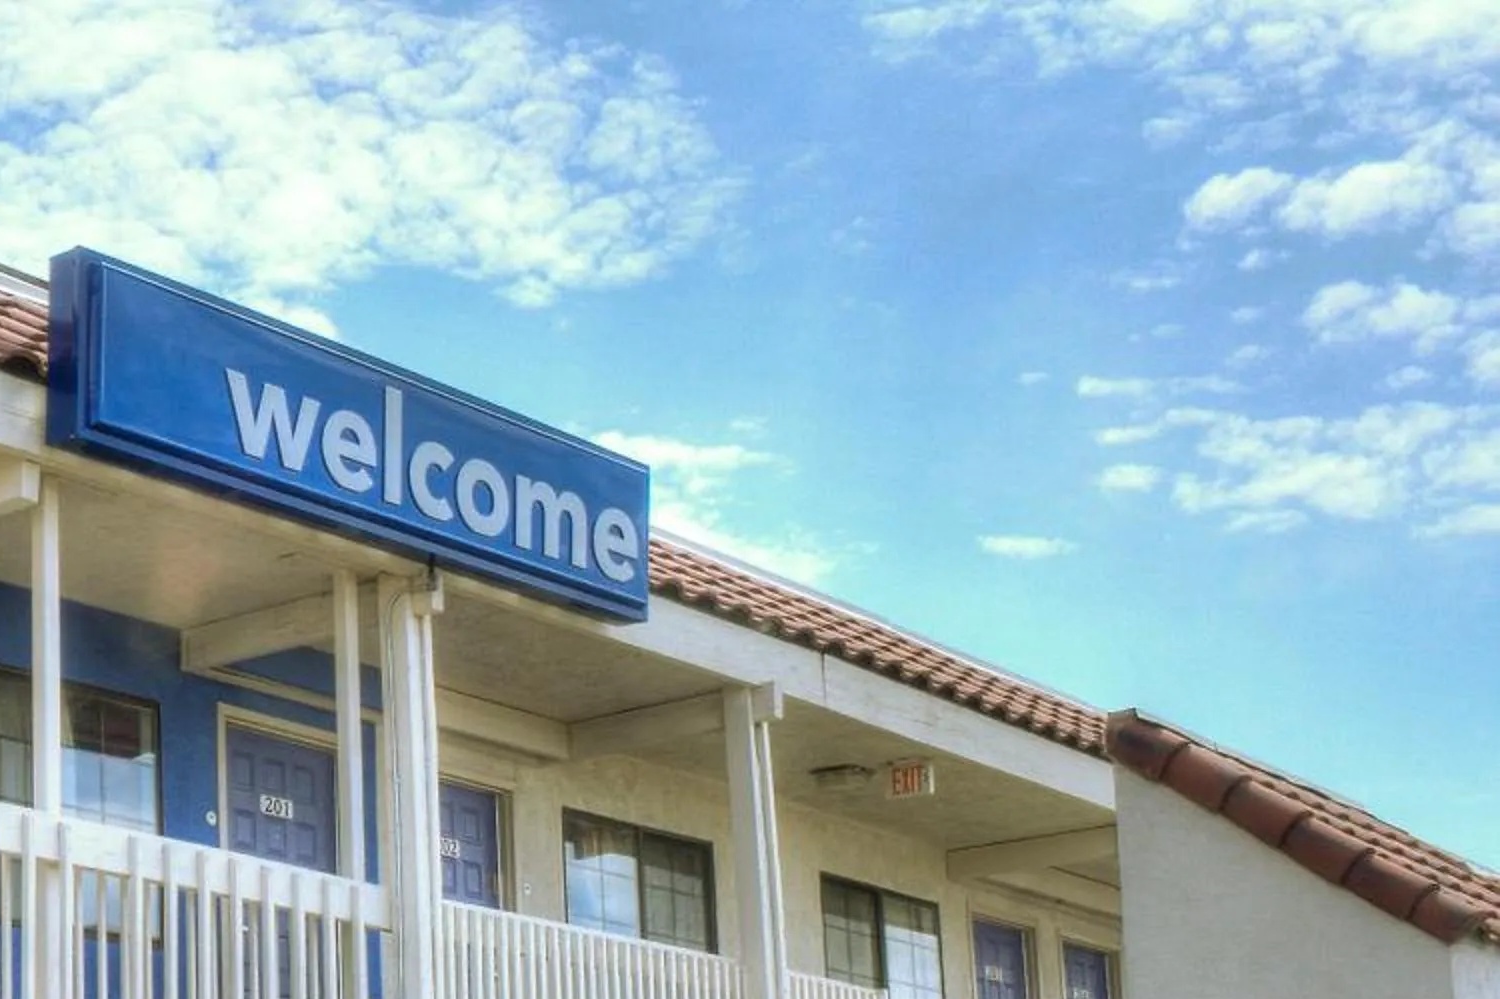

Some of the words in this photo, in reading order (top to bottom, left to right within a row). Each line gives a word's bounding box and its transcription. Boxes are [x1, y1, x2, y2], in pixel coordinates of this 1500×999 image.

[225, 367, 639, 583] welcome
[892, 766, 923, 795] EXIT
[264, 797, 289, 816] 201
